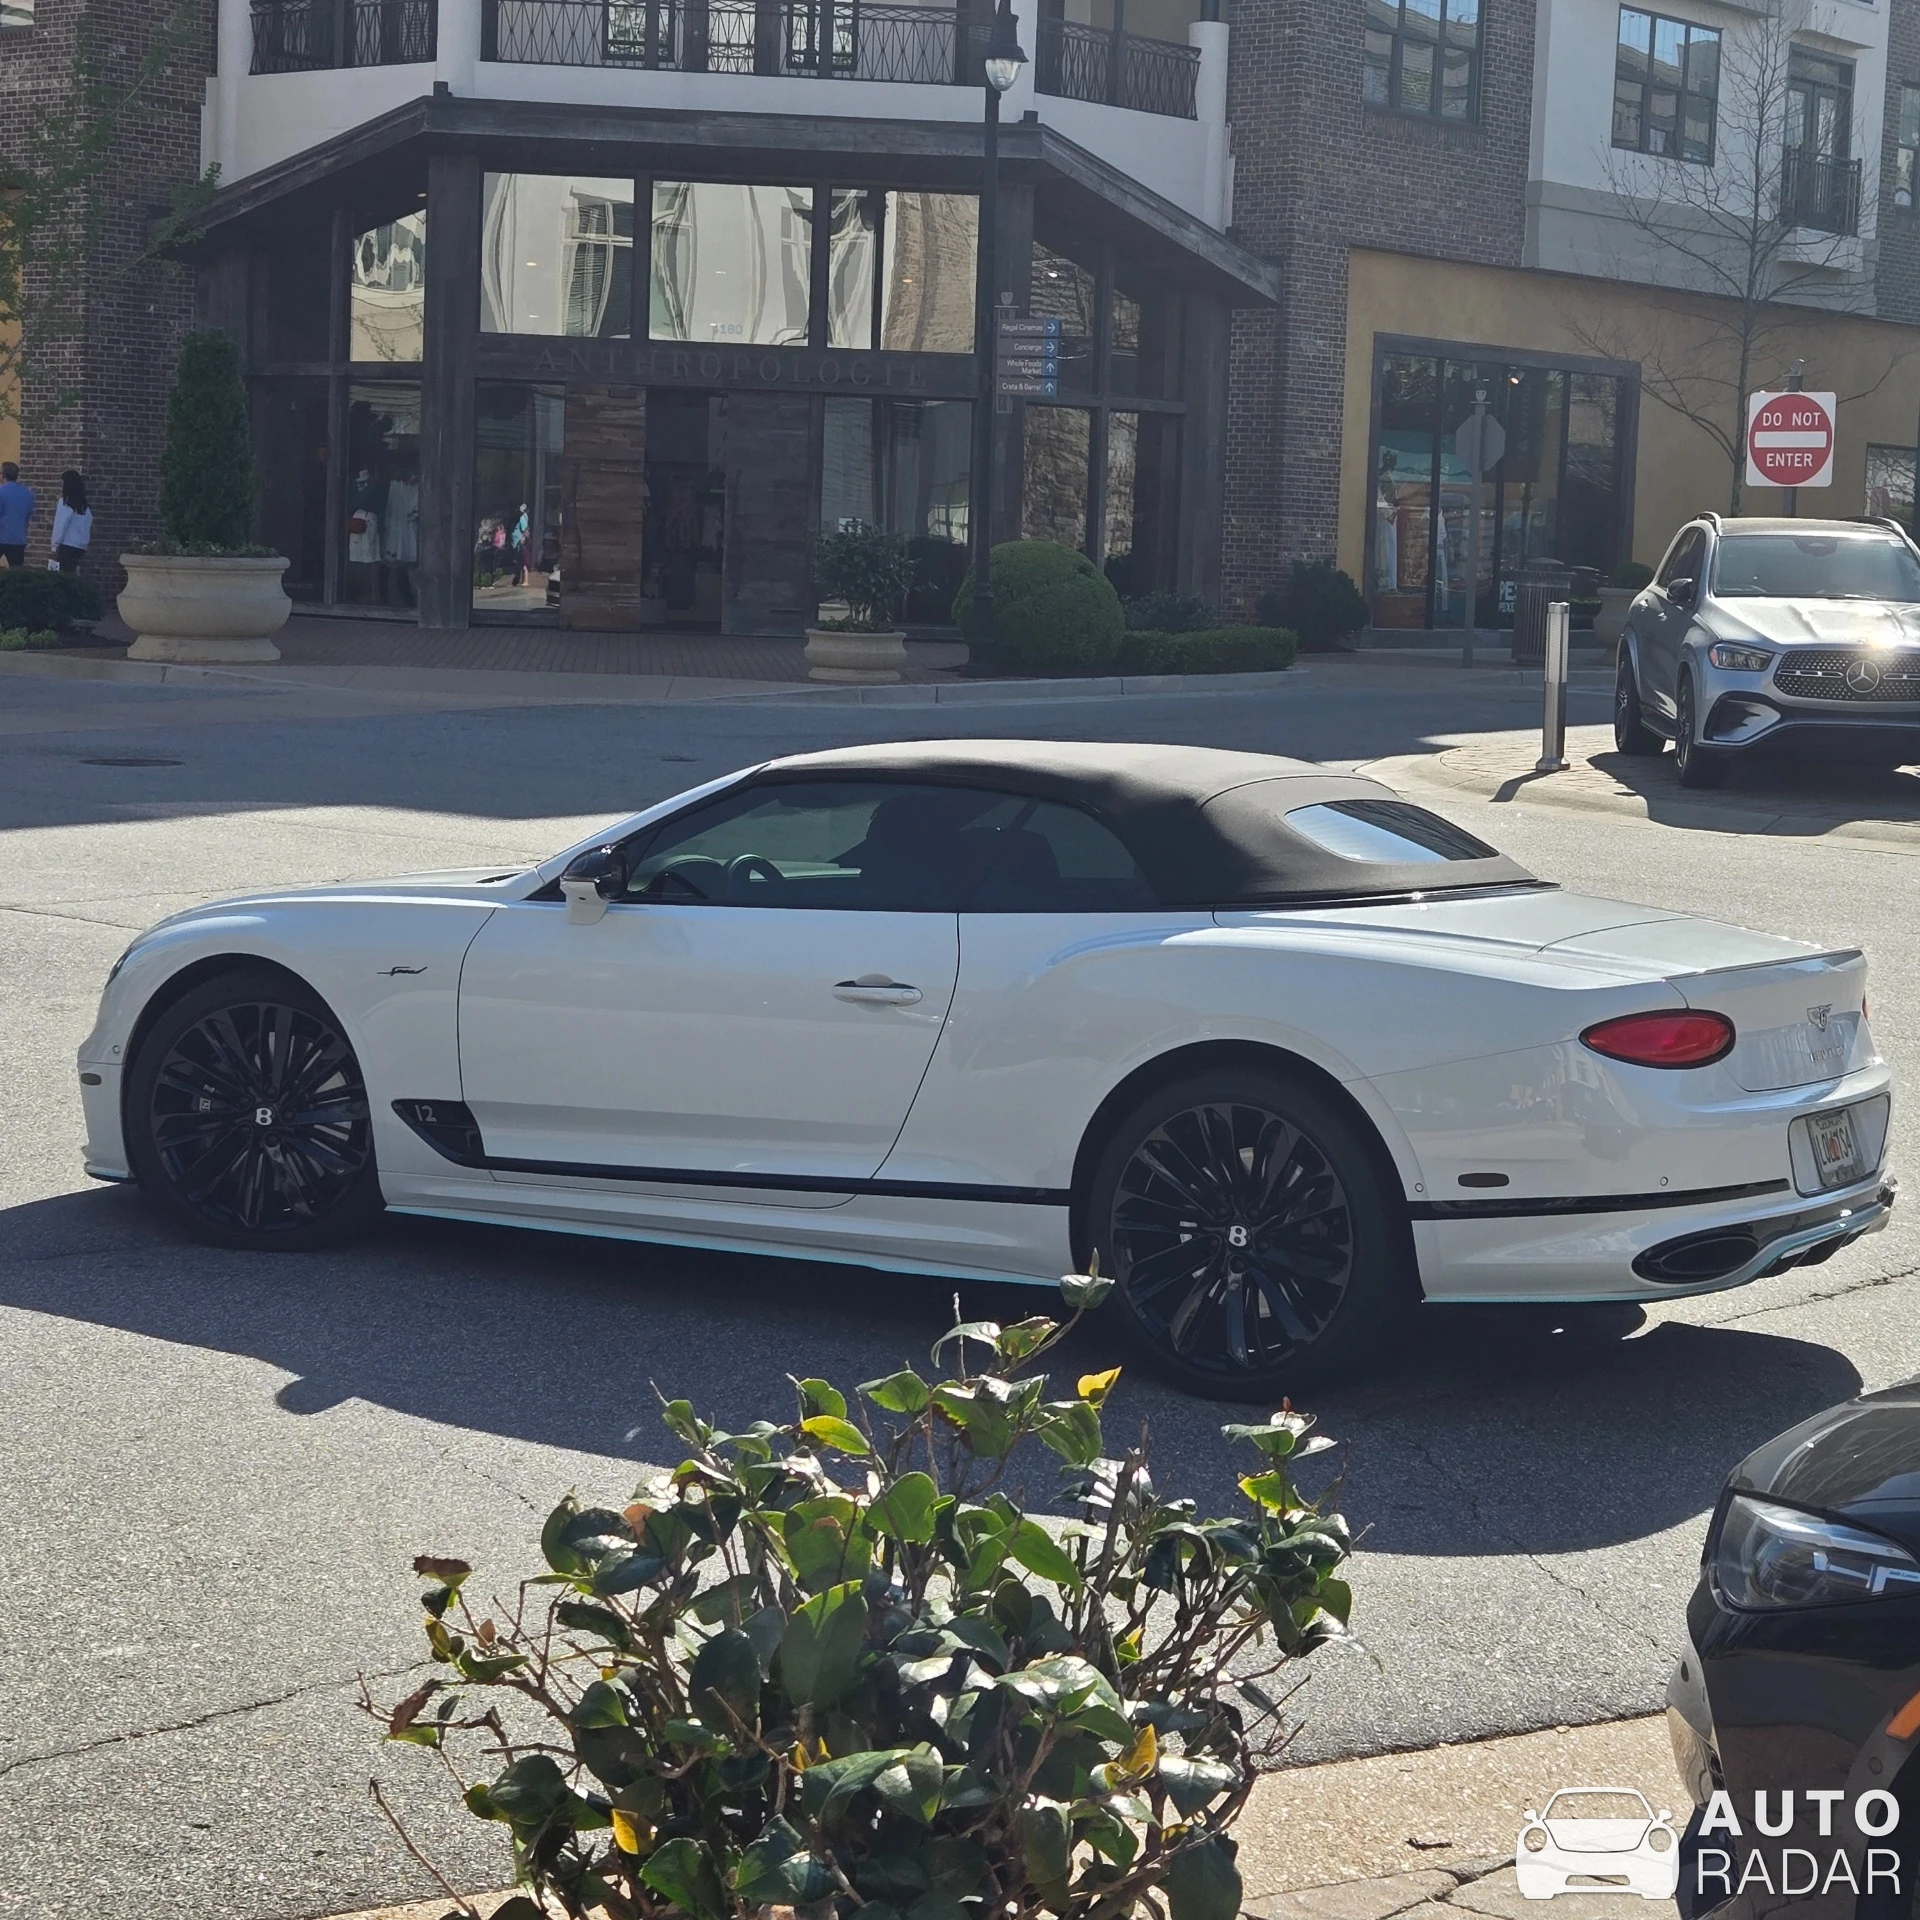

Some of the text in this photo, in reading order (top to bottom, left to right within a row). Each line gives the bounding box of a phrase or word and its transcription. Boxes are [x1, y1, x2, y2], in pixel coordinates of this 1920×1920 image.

[1002, 324, 1018, 332] Regal
[1014, 343, 1042, 351] Concierge
[533, 346, 928, 388] ANTHROPOLOGIE
[1007, 359, 1042, 367] Whole Foods
[1021, 367, 1042, 375] Market
[1024, 383, 1042, 391] Barrel
[1762, 412, 1821, 426] DO NOT
[1766, 453, 1813, 467] ENTER
[255, 1107, 273, 1126] B
[1228, 1225, 1247, 1247] B
